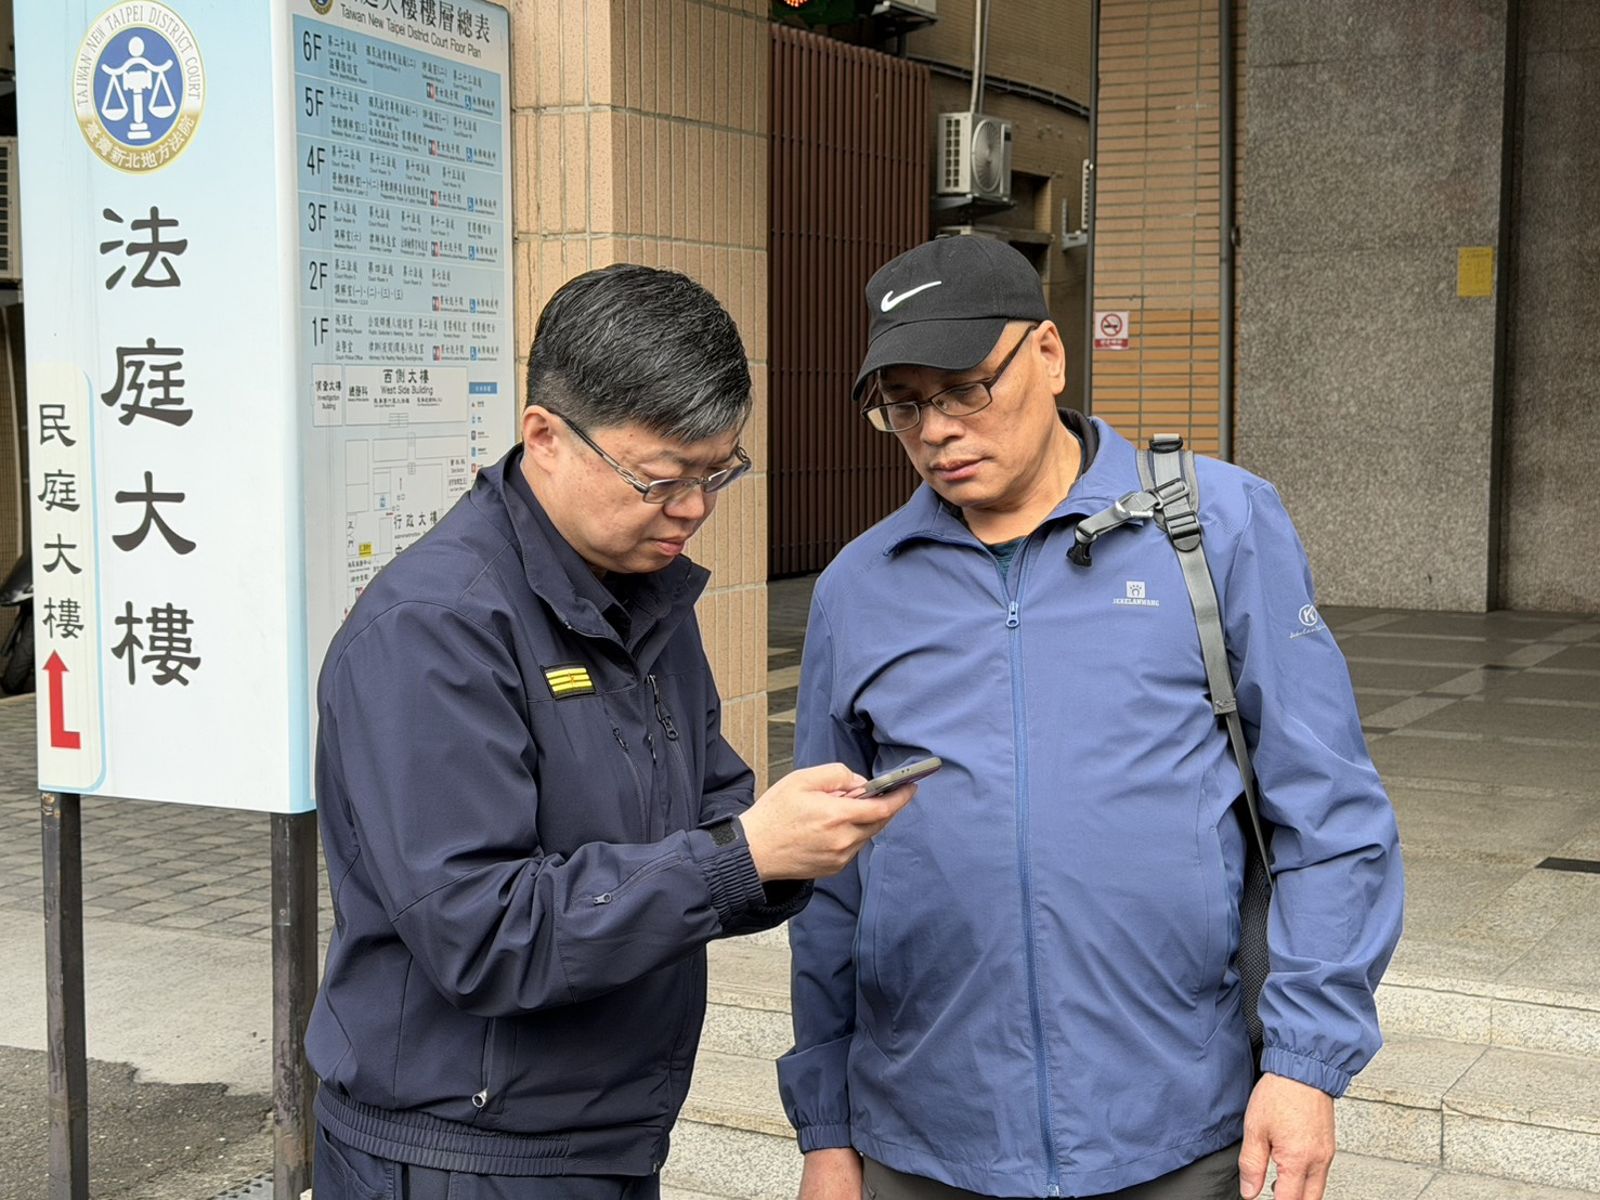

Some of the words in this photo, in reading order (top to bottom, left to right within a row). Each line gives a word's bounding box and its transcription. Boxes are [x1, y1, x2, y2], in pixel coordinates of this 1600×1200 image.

[341, 3, 367, 26] Taiwan
[368, 13, 384, 30] New
[386, 17, 405, 39] Taipei
[407, 25, 429, 45] District
[431, 32, 449, 50] Court
[451, 39, 466, 55] Floor
[468, 44, 482, 60] Plan
[352, 0, 490, 43] 樓樓層總表
[76, 53, 92, 107] TAIWAN
[86, 24, 106, 53] NEW
[105, 5, 144, 31] TAIPEI
[148, 7, 193, 54] DISTRICT
[185, 56, 201, 100] COURT
[303, 30, 322, 62] 6F
[305, 87, 324, 117] 5F
[85, 115, 195, 169] 臺灣新北地方法院
[307, 145, 325, 175] 4F
[308, 202, 327, 232] 3F
[309, 261, 328, 291] 2F
[312, 316, 329, 346] 1F
[383, 368, 429, 383] 西側大樓
[100, 206, 201, 686] 法庭大樓
[38, 404, 84, 639] 民庭大樓
